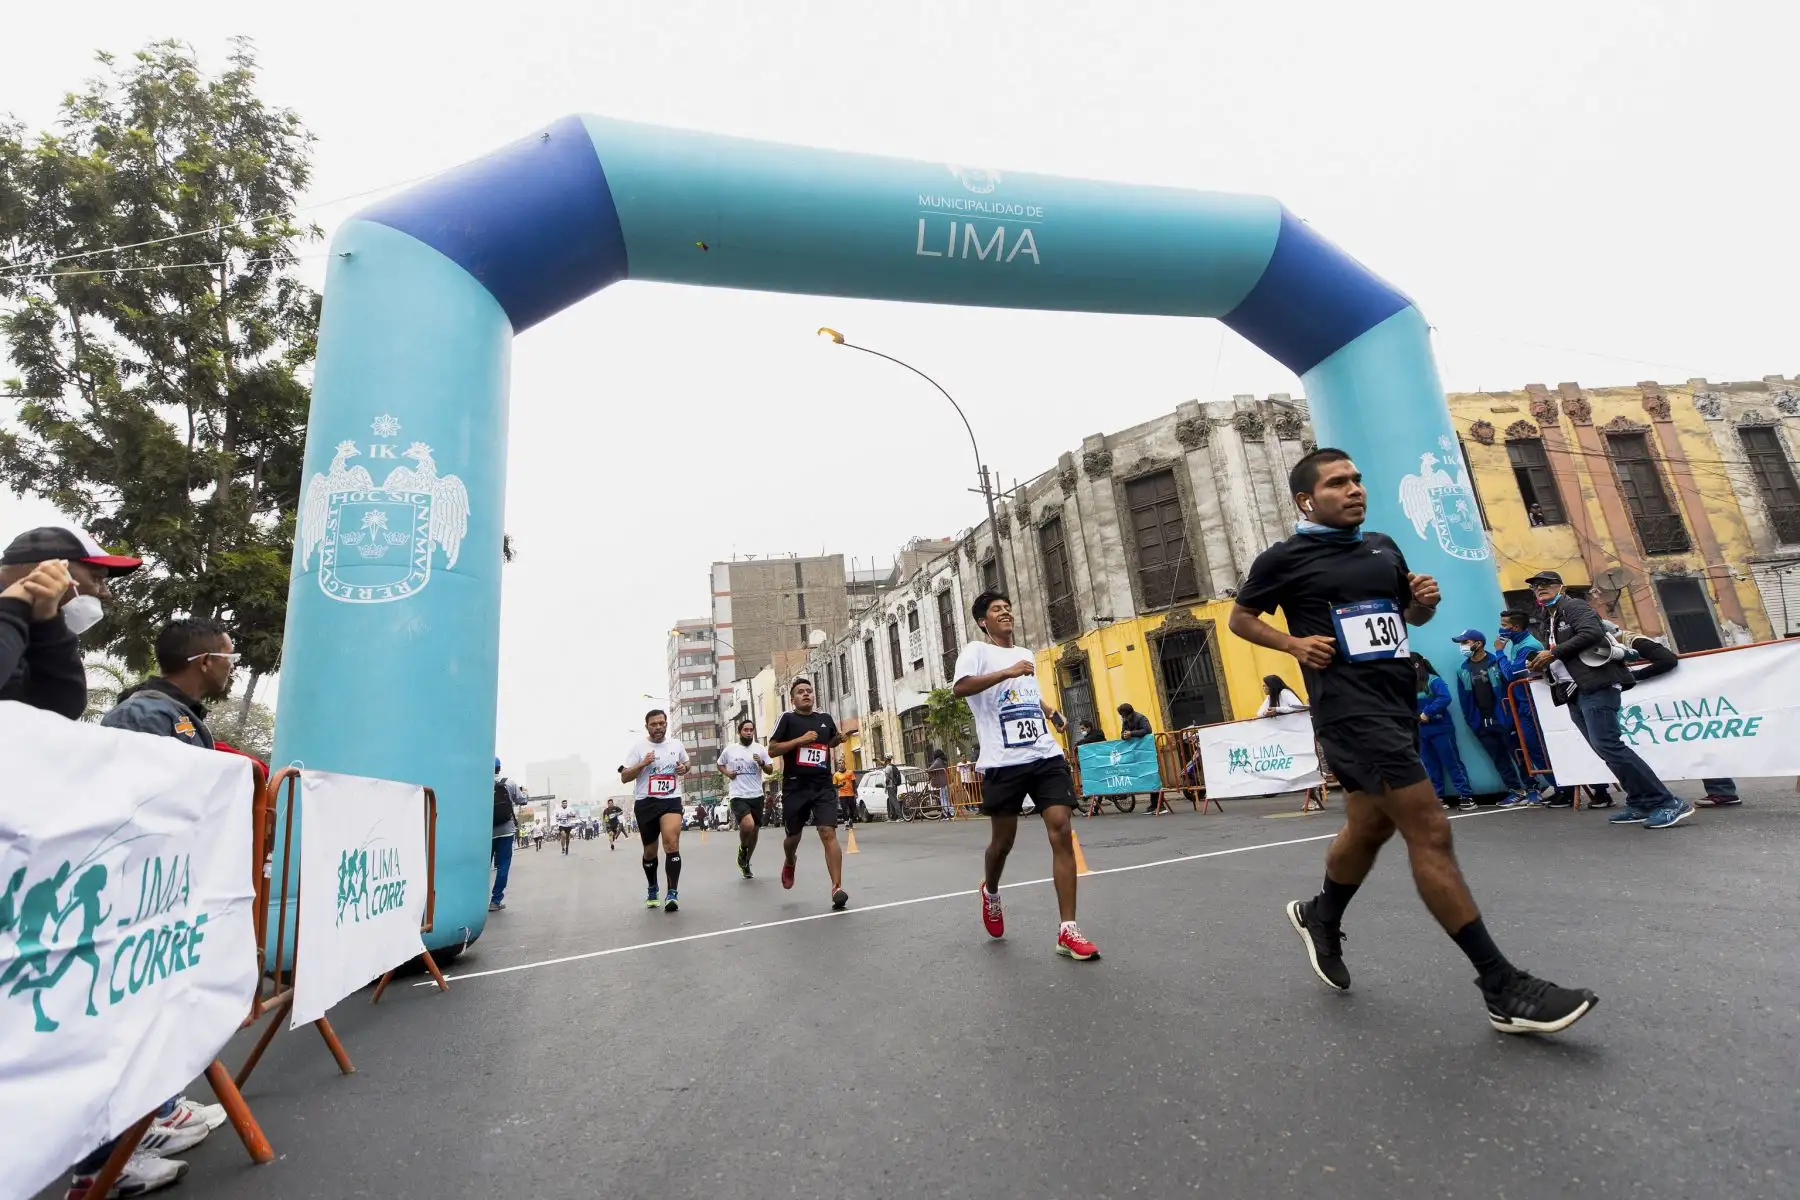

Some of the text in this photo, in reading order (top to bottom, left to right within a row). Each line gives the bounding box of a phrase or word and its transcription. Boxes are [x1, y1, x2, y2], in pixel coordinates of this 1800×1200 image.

[918, 193, 1044, 218] MUNICIPALIDAD DE
[916, 218, 1040, 265] LIMA
[368, 444, 399, 459] IK
[332, 491, 382, 505] HOC
[1365, 615, 1399, 647] 130
[1654, 696, 1739, 722] LIMA
[1017, 720, 1038, 739] 236
[1664, 716, 1763, 743] CORRE
[807, 749, 821, 762] 715
[1253, 744, 1285, 759] LIMA
[1255, 757, 1293, 772] CORRE
[657, 780, 670, 791] 724
[1107, 776, 1132, 788] LIMA
[372, 847, 401, 881] LIMA
[372, 879, 407, 916] CORRE
[109, 912, 209, 1006] CORRE
